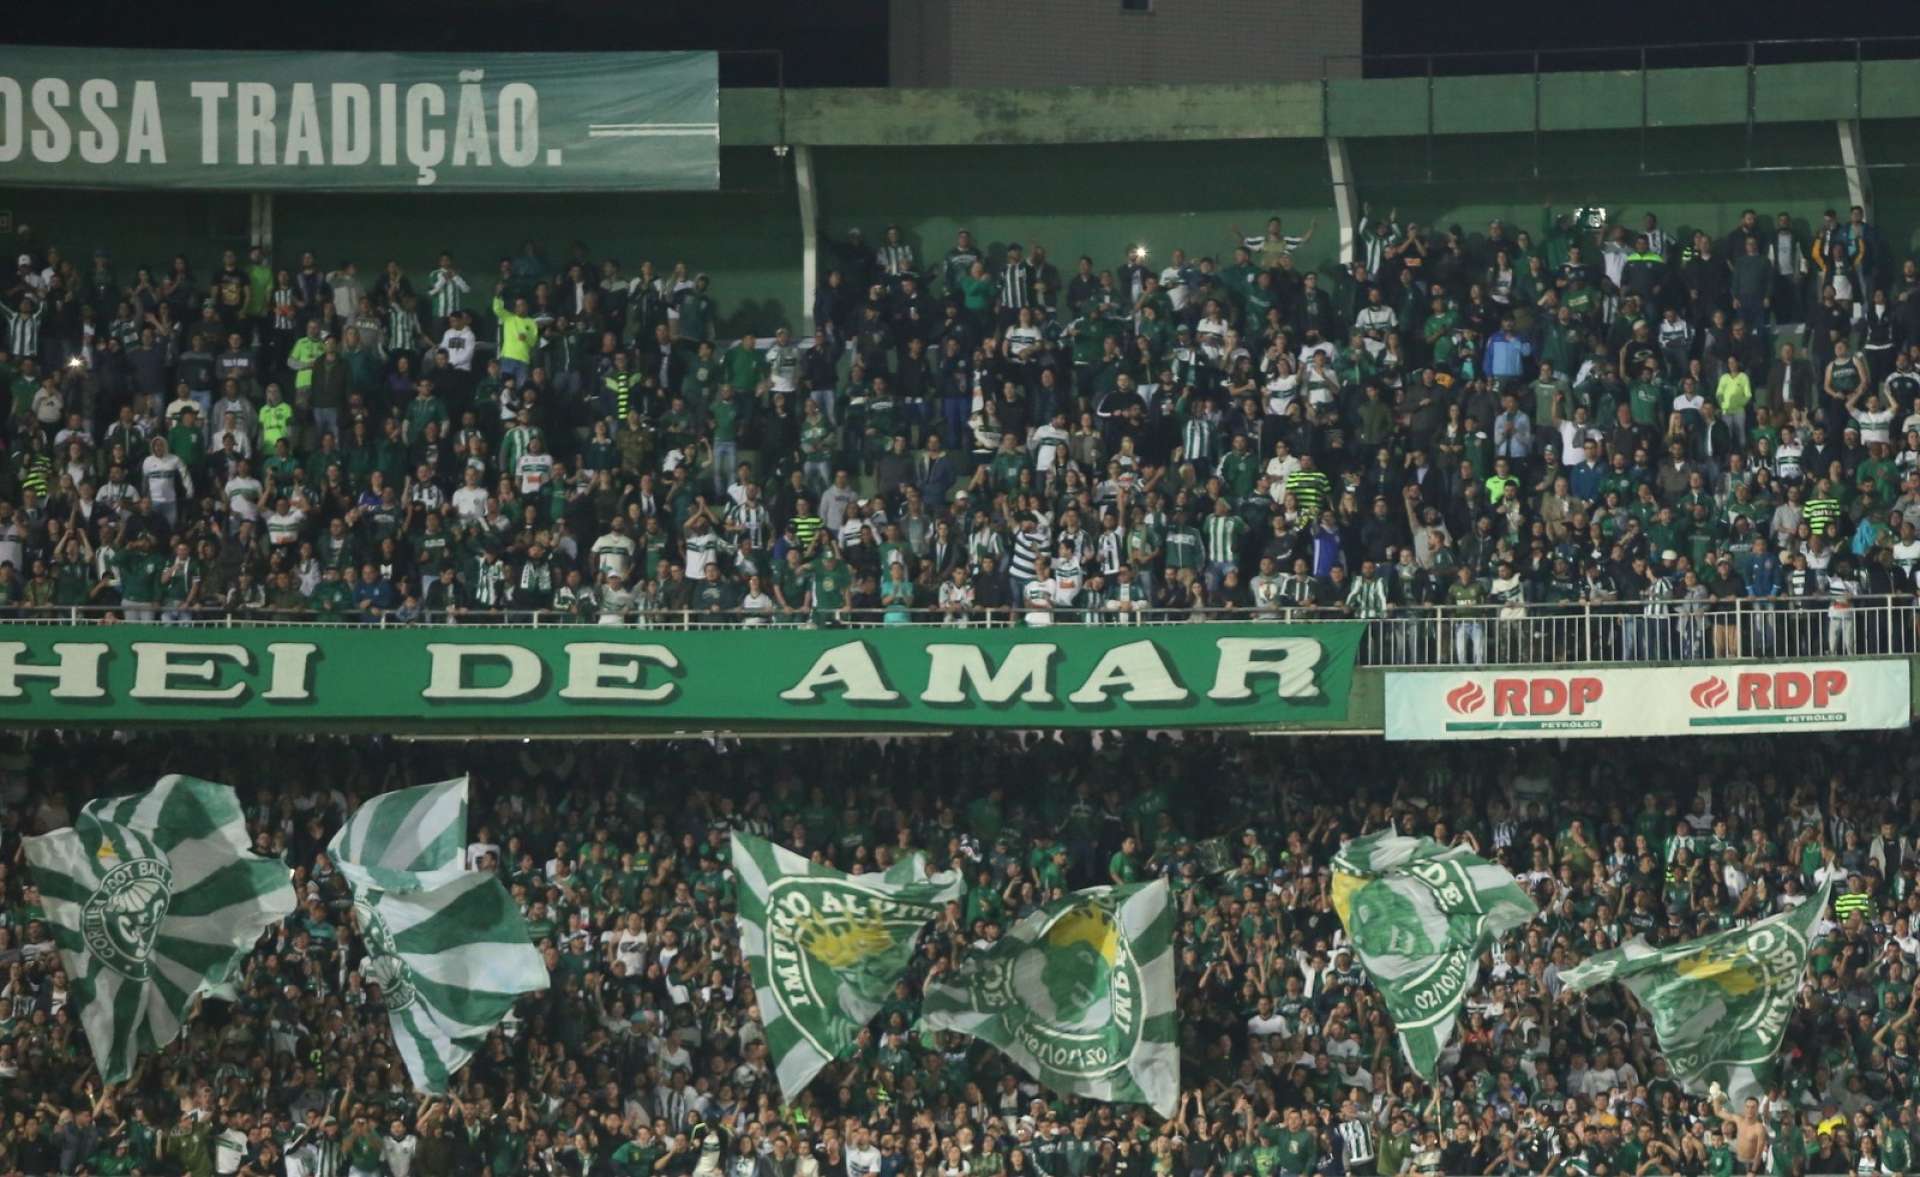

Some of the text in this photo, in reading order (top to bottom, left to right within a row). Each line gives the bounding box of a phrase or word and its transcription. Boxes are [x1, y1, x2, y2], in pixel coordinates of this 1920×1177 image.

[191, 69, 563, 187] TRADIÇÃO.
[422, 642, 680, 700] DE
[779, 637, 1324, 703] AMAR
[1737, 670, 1848, 711] RDP
[1494, 677, 1604, 717] RDP
